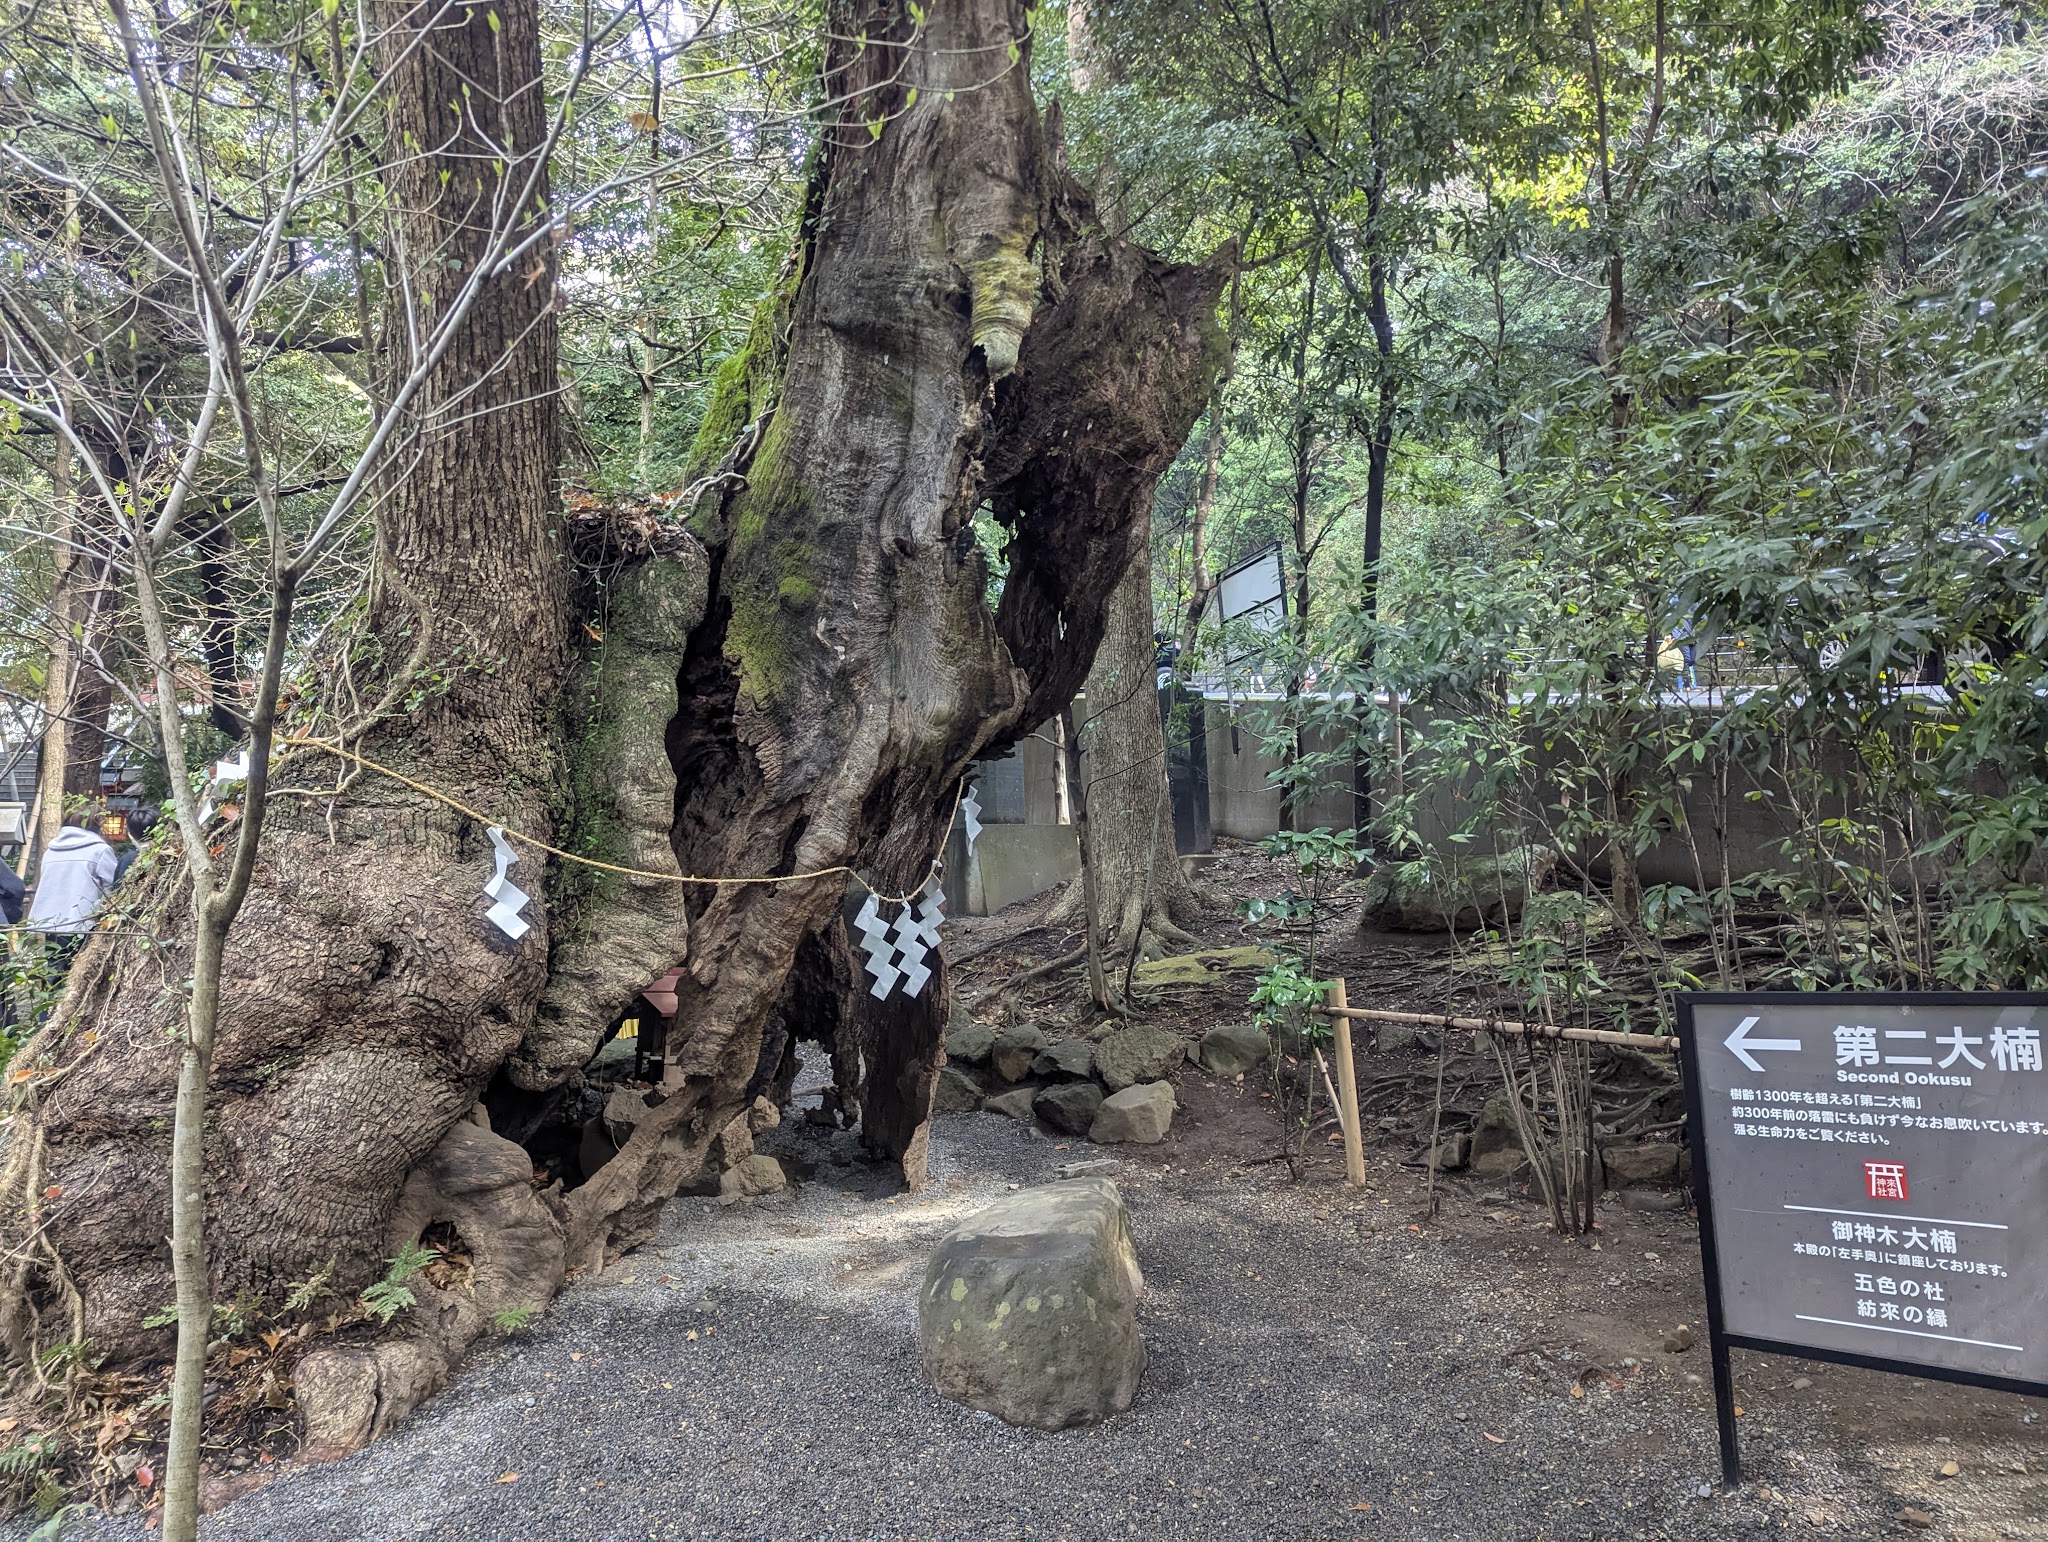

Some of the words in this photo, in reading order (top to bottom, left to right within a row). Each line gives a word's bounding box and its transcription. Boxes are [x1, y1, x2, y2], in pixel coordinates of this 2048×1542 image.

[1832, 1025, 2043, 1072] 第二大楠
[1836, 1070, 1899, 1085] Second
[1904, 1072, 1972, 1087] Ookusu
[1854, 1272, 1946, 1302] 五色の杜
